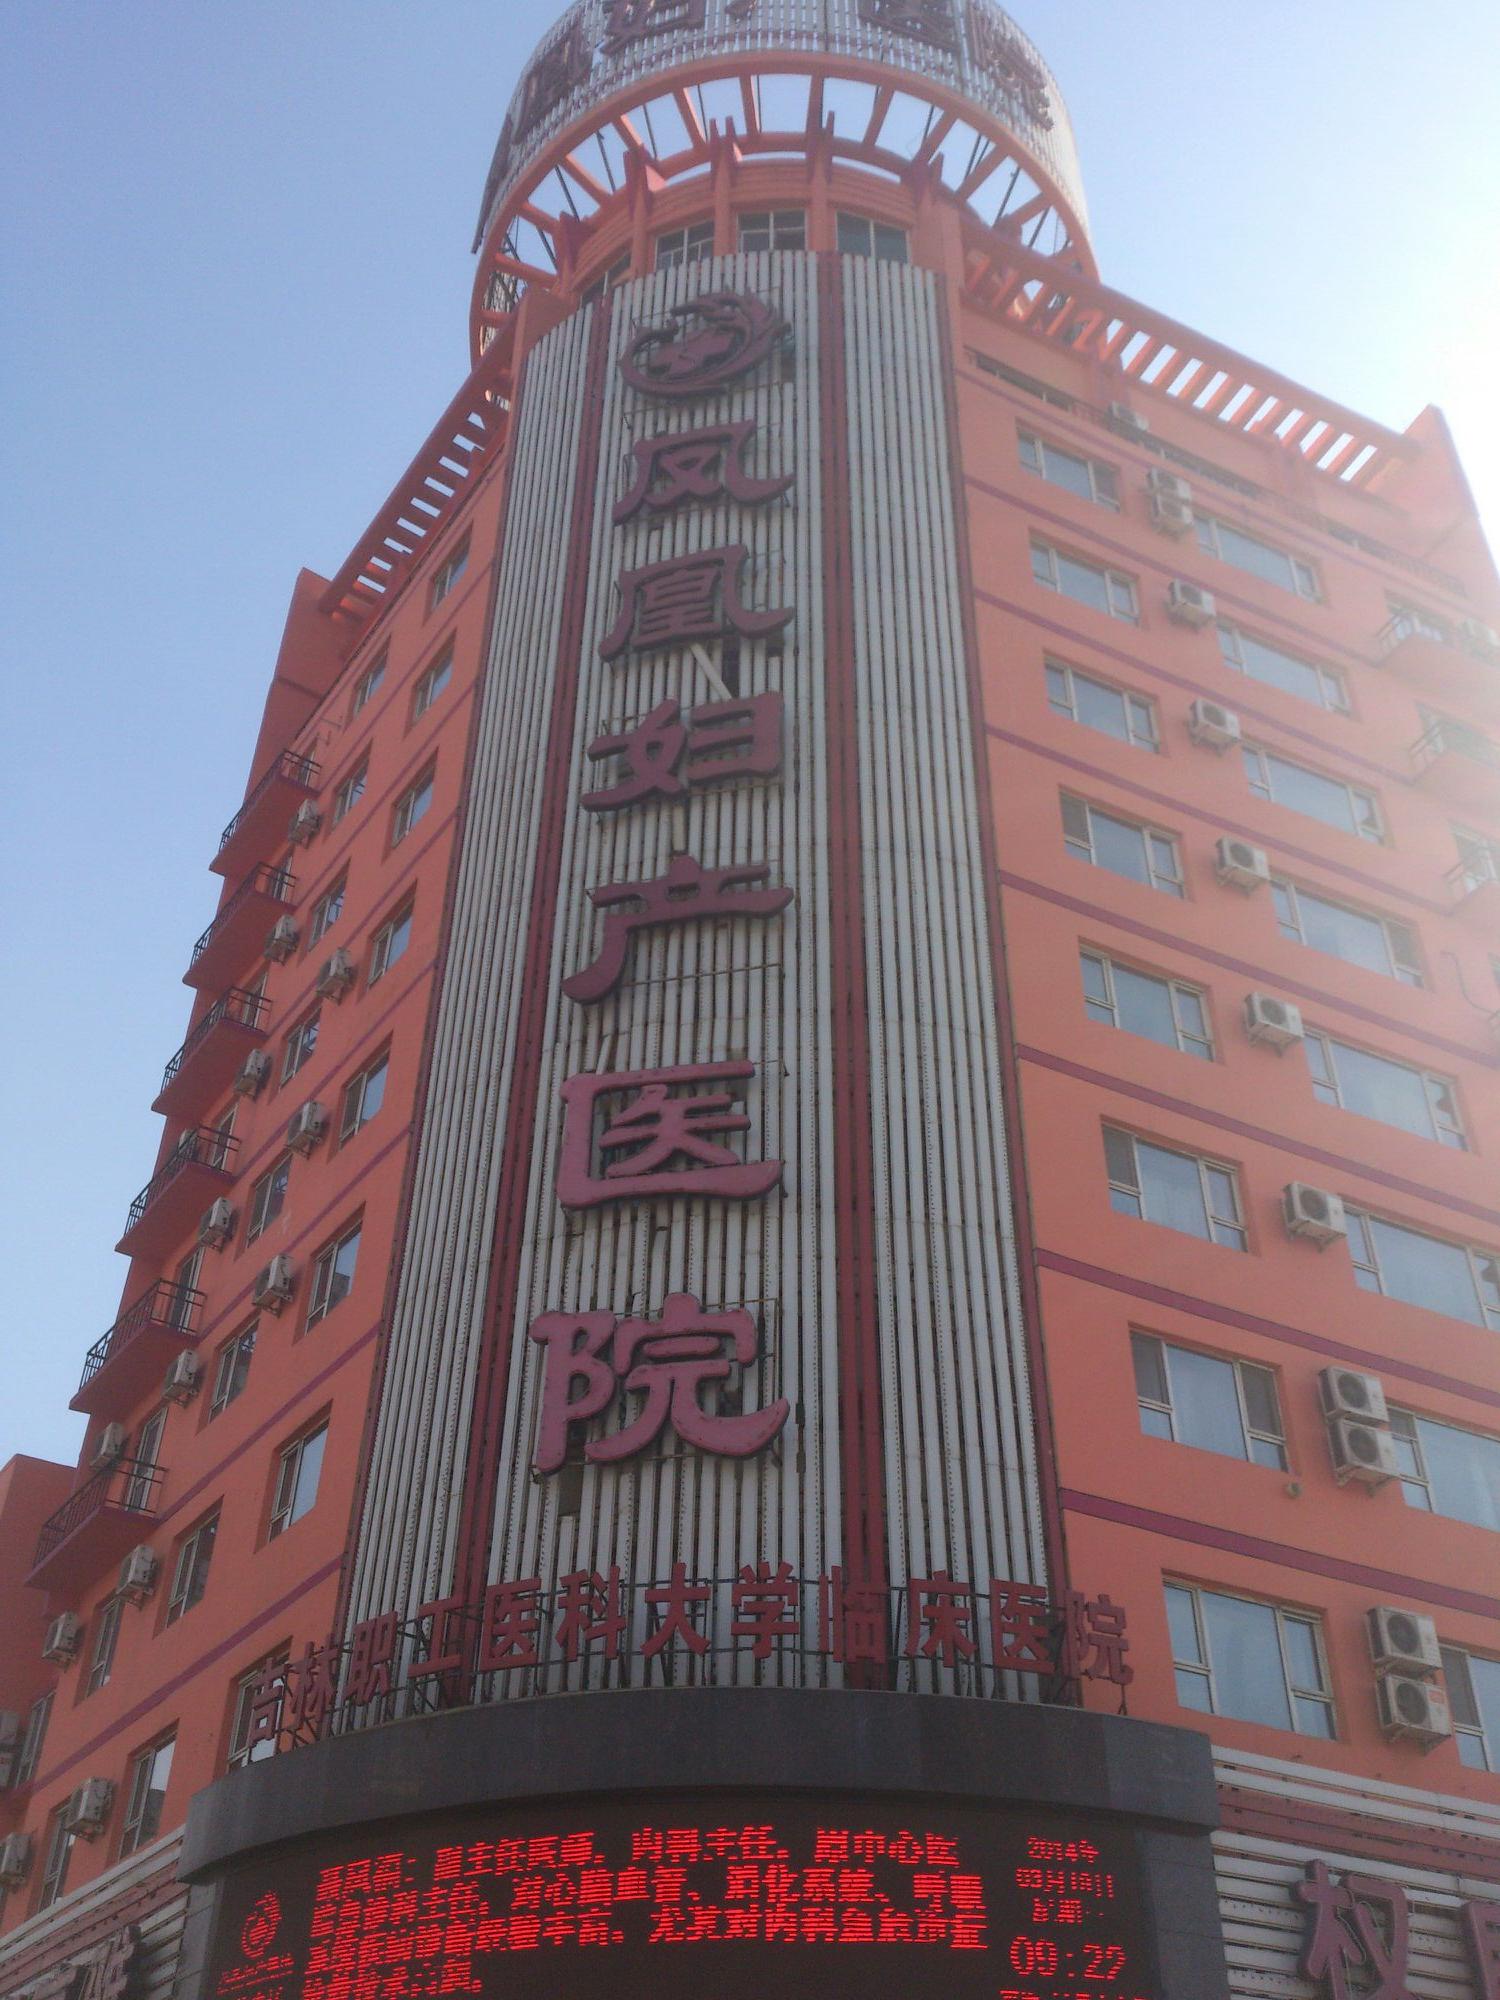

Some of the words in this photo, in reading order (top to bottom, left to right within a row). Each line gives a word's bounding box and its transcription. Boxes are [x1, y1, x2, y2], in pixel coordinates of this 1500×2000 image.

[530, 418, 796, 1476] 凤凰妇产医院
[248, 1560, 1134, 1743] 吉林职工医科大学临床医院
